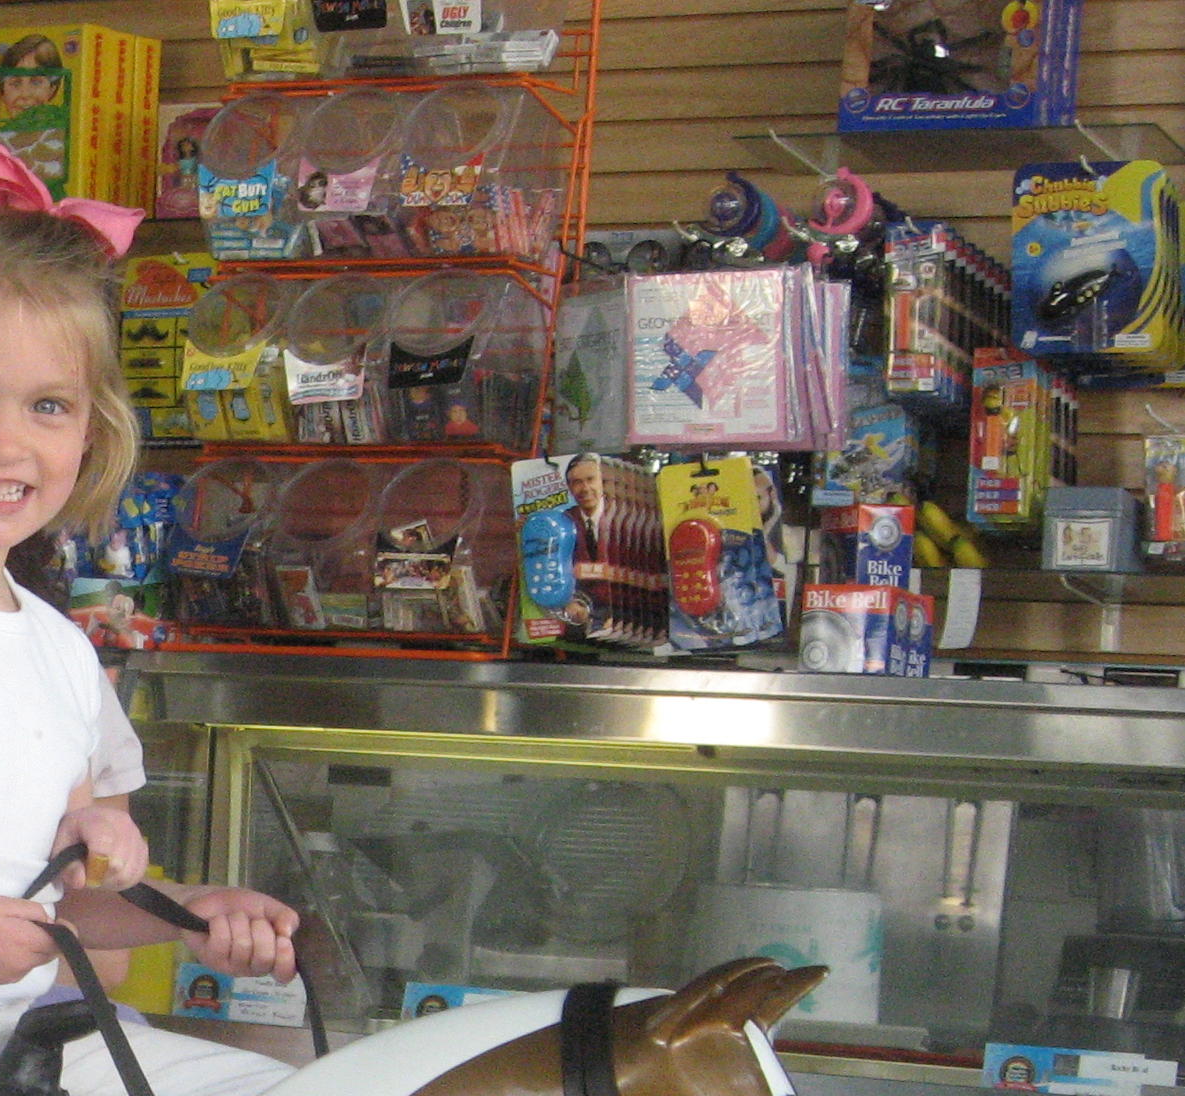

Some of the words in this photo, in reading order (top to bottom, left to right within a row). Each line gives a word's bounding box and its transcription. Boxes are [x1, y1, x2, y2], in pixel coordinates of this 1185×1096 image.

[442, 6, 469, 19] UGLY
[876, 97, 908, 111] RC
[912, 95, 994, 110] Tarantula
[522, 471, 562, 489] MISTER
[867, 560, 903, 577] Bike
[805, 590, 847, 608] Bike
[851, 591, 888, 609] Bell
